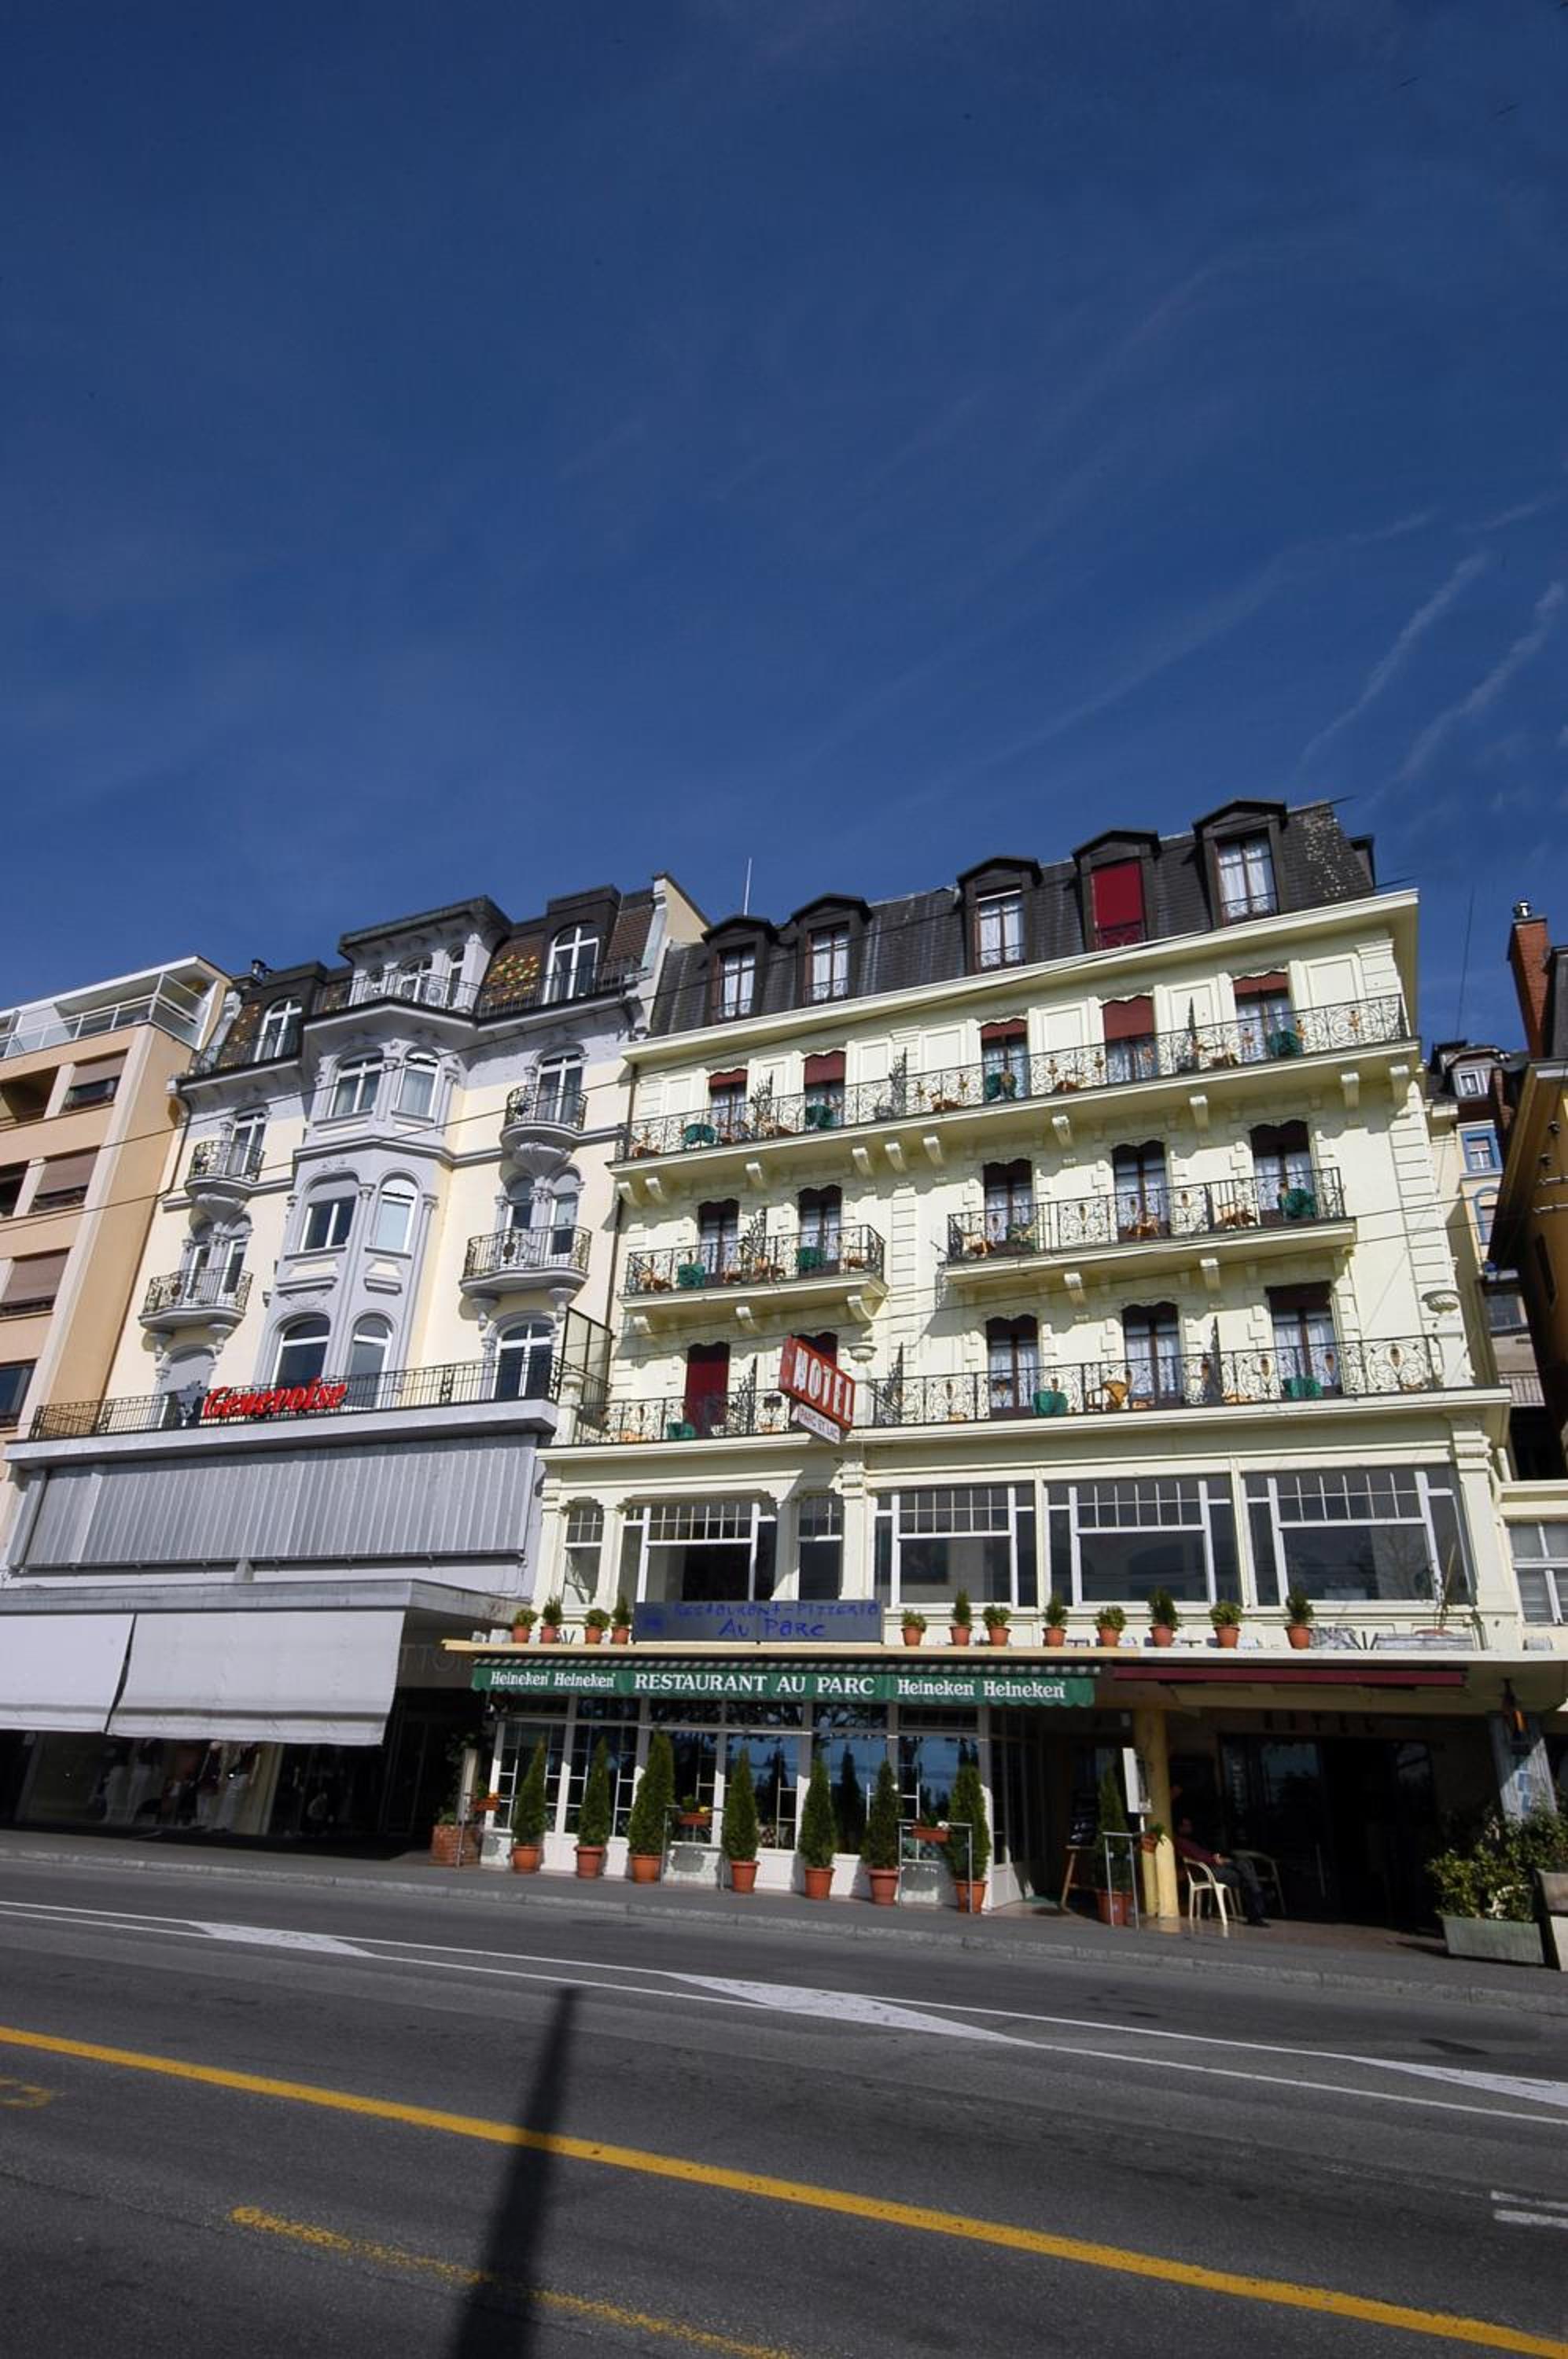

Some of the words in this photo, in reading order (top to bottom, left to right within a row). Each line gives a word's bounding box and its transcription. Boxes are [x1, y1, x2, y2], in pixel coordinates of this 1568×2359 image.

[202, 1377, 348, 1418] Genevoise
[793, 1346, 852, 1422] HOTEL
[490, 1670, 549, 1686] Heineken
[554, 1673, 615, 1688] Heineken
[634, 1673, 767, 1692] RESTAURANT
[776, 1676, 807, 1694] AU
[816, 1676, 875, 1695] PARC
[897, 1678, 975, 1696] Heineken
[983, 1680, 1066, 1699] Heineken
